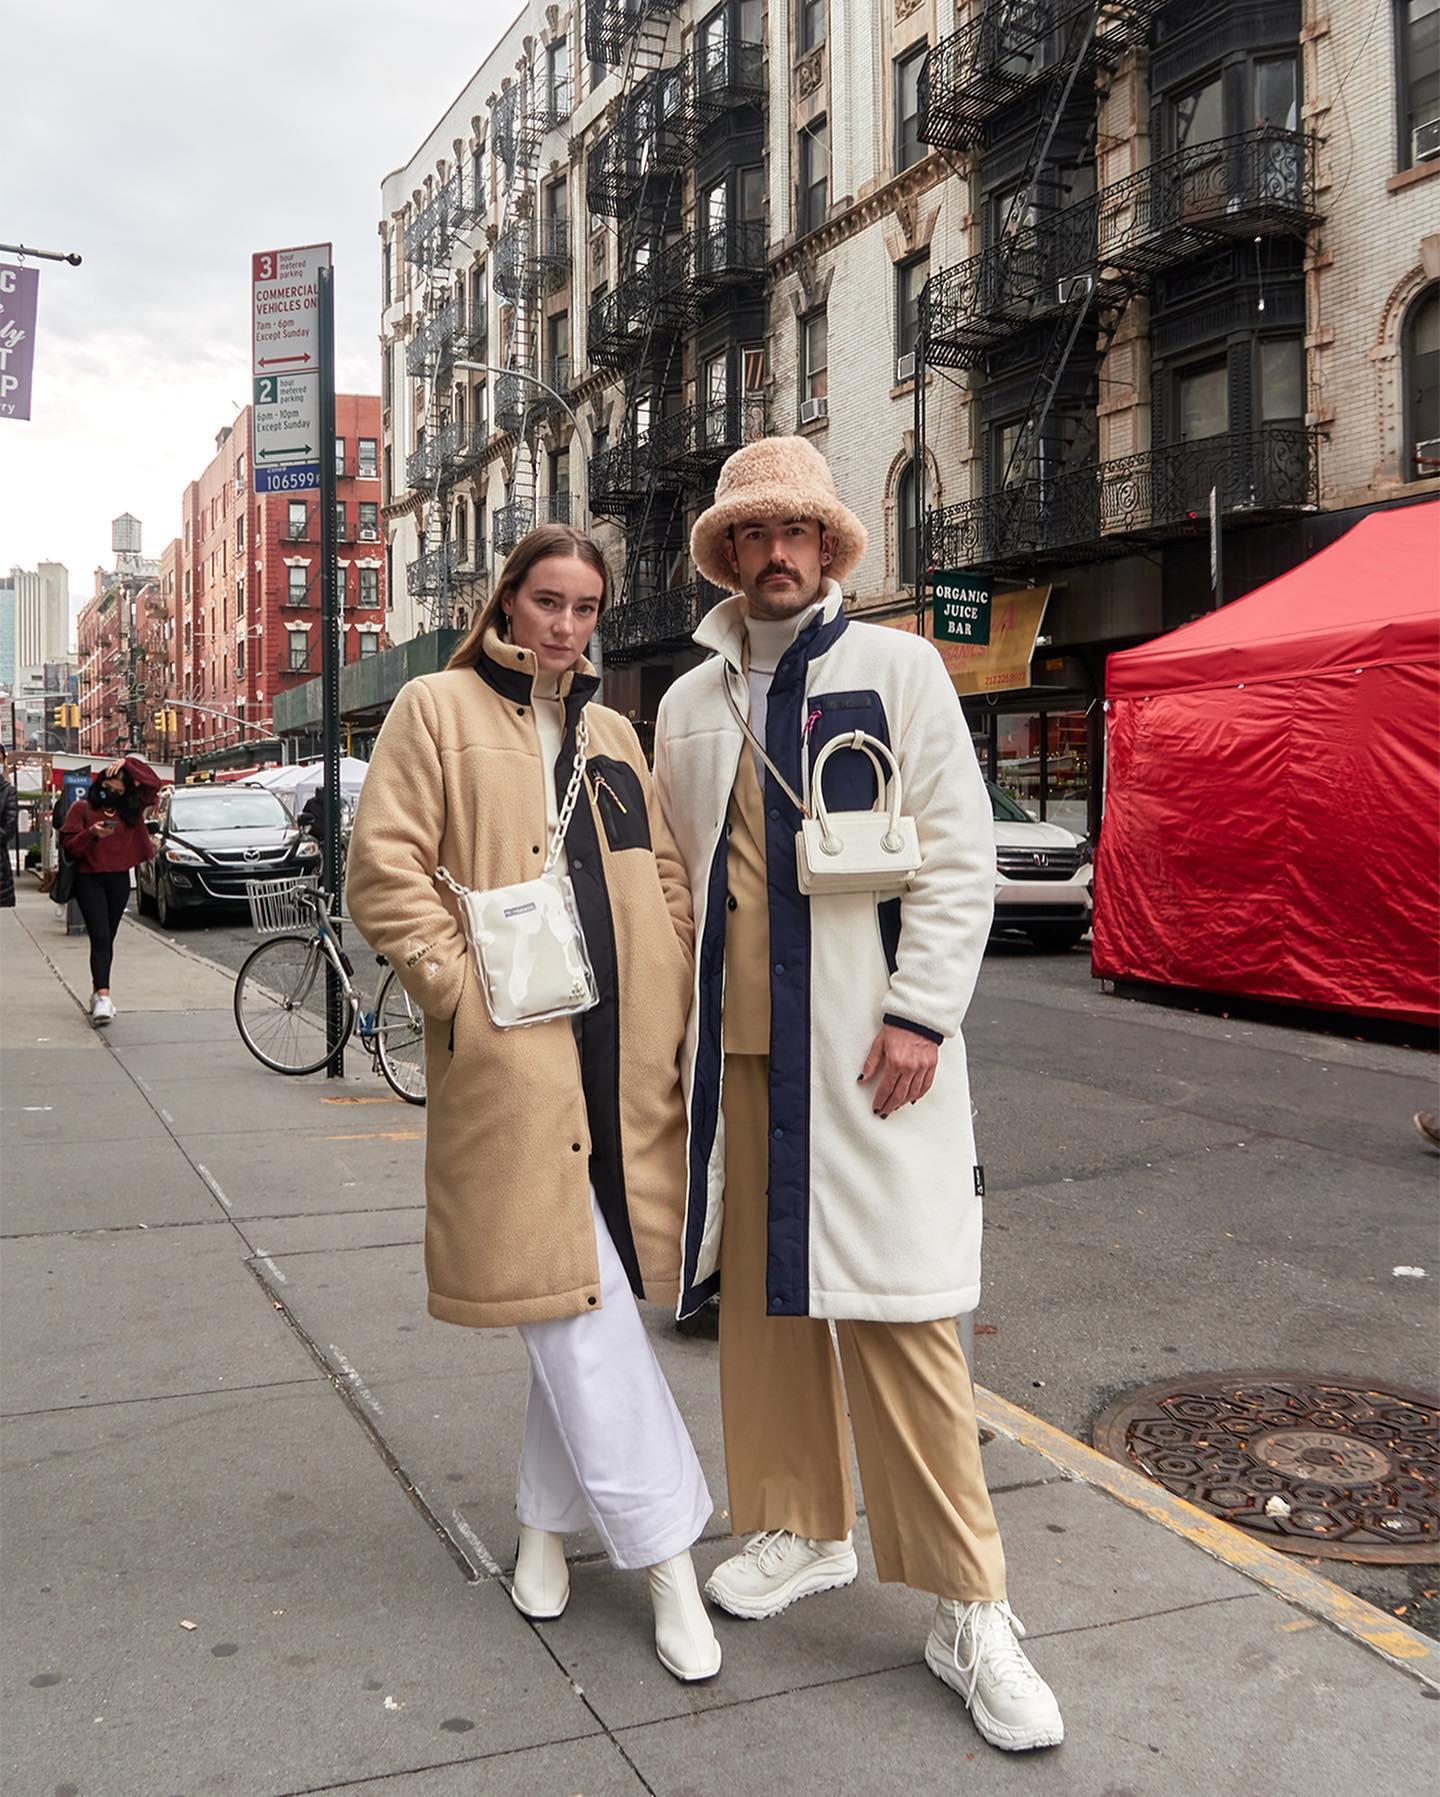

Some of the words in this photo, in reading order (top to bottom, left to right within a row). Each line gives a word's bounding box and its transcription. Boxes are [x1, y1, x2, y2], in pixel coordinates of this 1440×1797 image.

[260, 255, 272, 279] 3
[280, 260, 306, 270] metered
[280, 270, 303, 279] parking
[256, 284, 319, 302] COMMERCIAL
[256, 299, 301, 315] VEHICLES
[303, 297, 319, 310] ON
[256, 321, 271, 330] 7am
[278, 319, 294, 330] 6pm
[256, 330, 282, 342] Except
[282, 328, 310, 339] Sunday
[1, 375, 18, 397] P
[259, 379, 272, 403] 2
[280, 386, 307, 395] metered
[280, 395, 304, 404] parking
[257, 412, 273, 422] 6pm
[280, 409, 300, 420] 10pm
[257, 421, 282, 433] Except
[283, 420, 311, 431] Sunday
[935, 585, 989, 604] ORGANIC
[943, 603, 978, 620] JUICE
[947, 620, 972, 636] BAR
